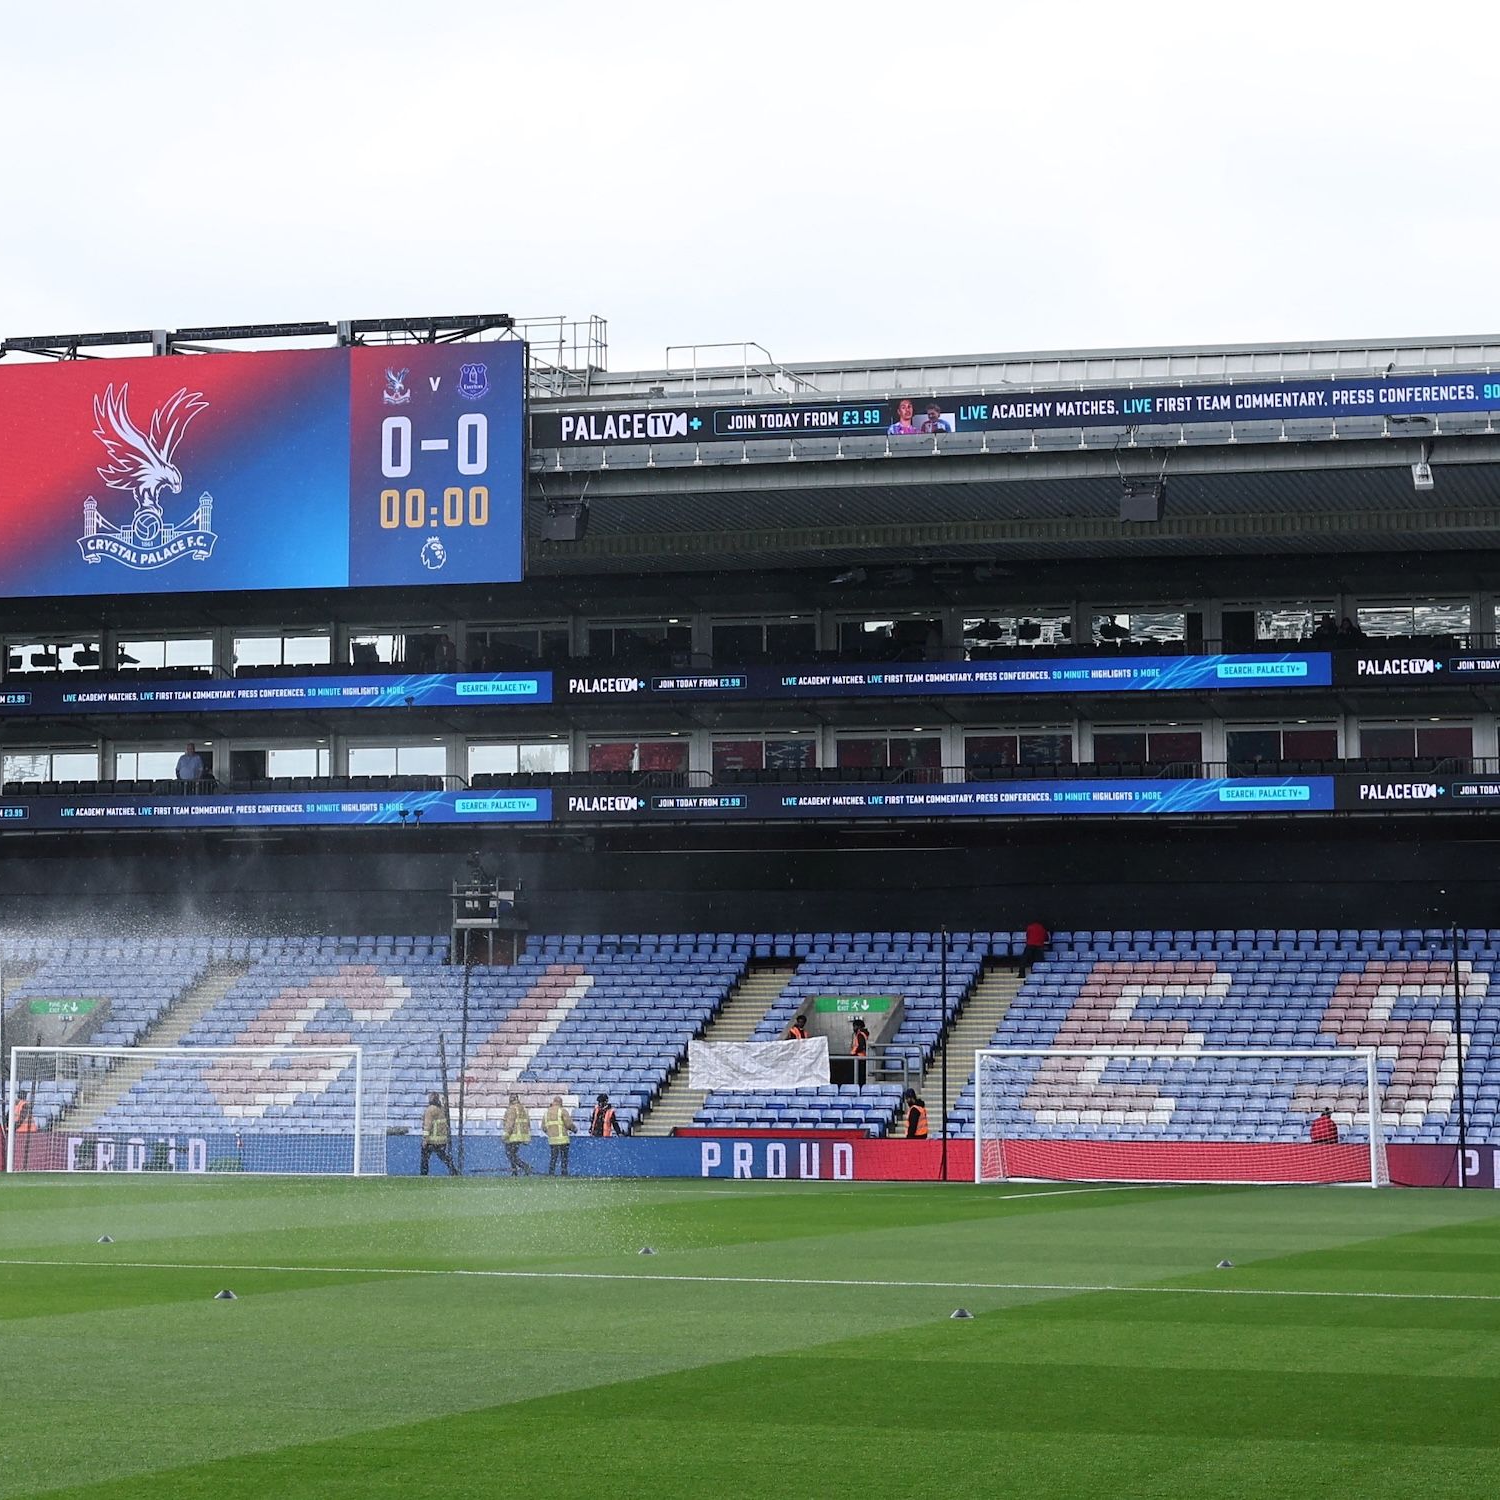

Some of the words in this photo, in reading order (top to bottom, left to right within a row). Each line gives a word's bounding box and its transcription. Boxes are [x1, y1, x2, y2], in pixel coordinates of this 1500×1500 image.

[728, 414, 756, 430] JOIN
[760, 413, 799, 428] TODAY
[804, 411, 838, 427] FROM
[843, 409, 881, 425] £3.99
[961, 405, 987, 420] LIVE
[992, 403, 1051, 419] ACADEMY
[1124, 398, 1151, 413] LIVE
[1157, 397, 1192, 412] FIRST
[1196, 395, 1230, 411] TEAM
[1333, 389, 1374, 405] PRESS
[381, 413, 488, 478] 0-0
[380, 487, 488, 529] 00:00
[87, 539, 137, 564] CRYSTAL
[140, 541, 185, 564] PALACE
[187, 536, 207, 547] F.C.
[701, 1142, 853, 1180] PROUD
